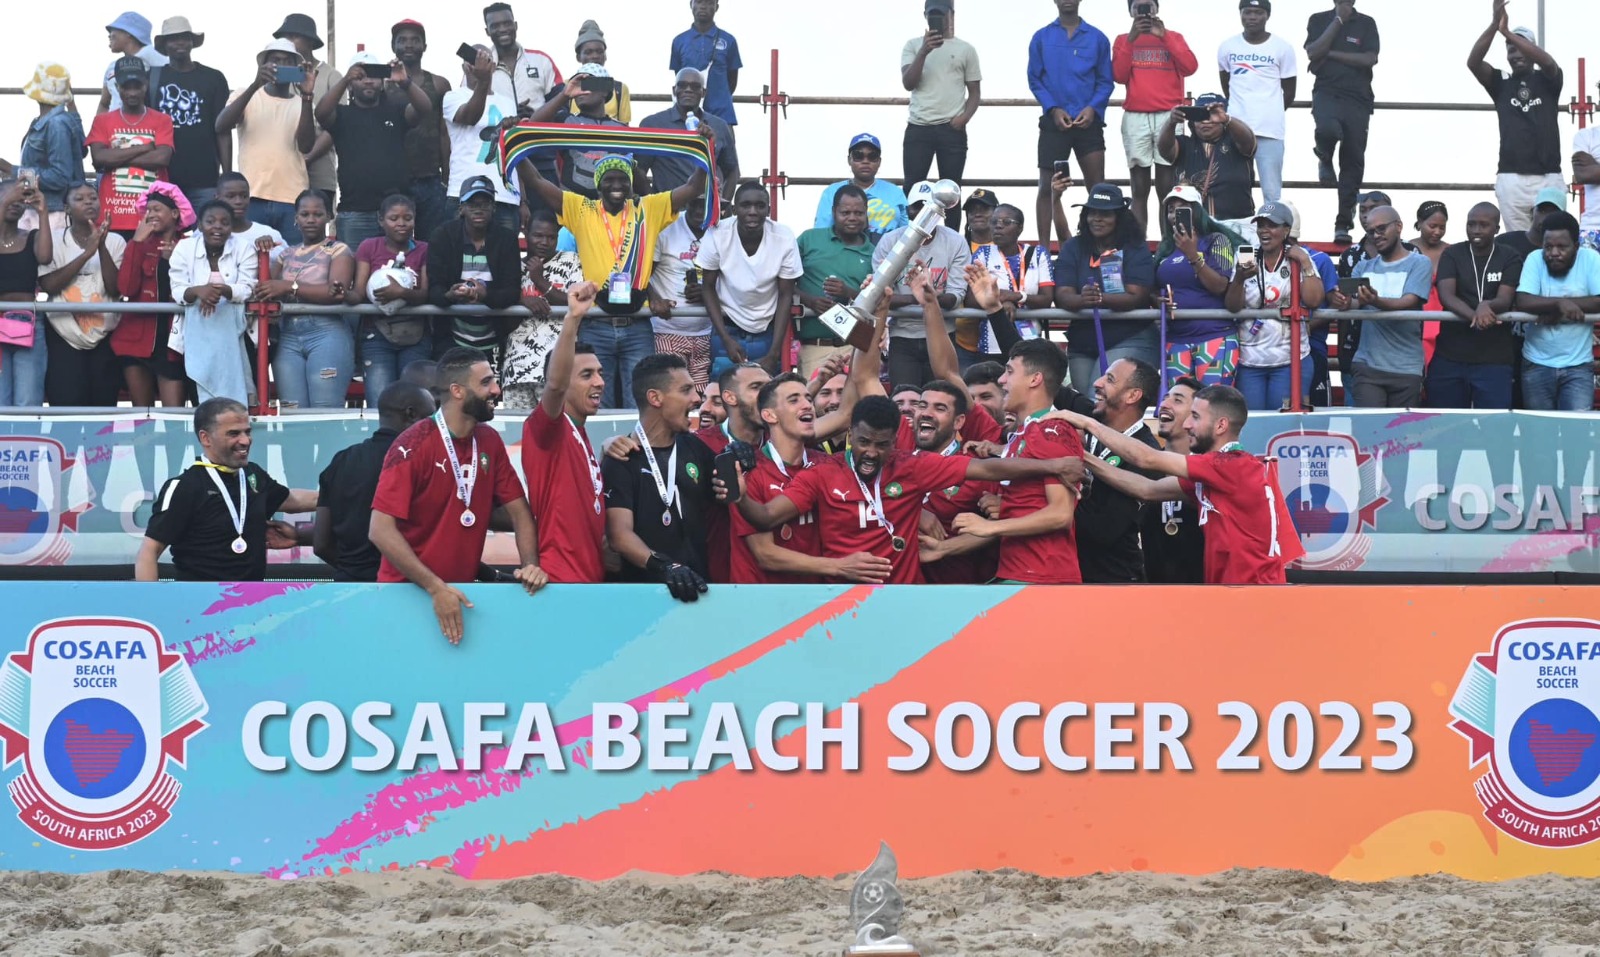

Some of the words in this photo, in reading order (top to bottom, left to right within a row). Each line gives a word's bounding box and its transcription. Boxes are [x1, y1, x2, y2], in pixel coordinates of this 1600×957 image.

[1229, 53, 1275, 64] Reebok
[106, 197, 136, 207] Working
[0, 450, 53, 462] SAFA
[1277, 444, 1348, 459] COSAFA
[0, 465, 29, 473] BEACH
[1299, 461, 1327, 470] BEACH
[1297, 470, 1329, 478] SOCCER
[1414, 483, 1600, 531] COSAF
[858, 500, 886, 528] 14
[43, 640, 147, 660] COSAFA
[75, 665, 115, 676] BEACH
[1538, 666, 1577, 676] BEACH
[73, 677, 118, 688] SOCCER
[1536, 678, 1579, 689] SOCCER
[241, 700, 566, 771] COSAFA
[593, 701, 860, 771] BEACH
[886, 700, 1194, 771] SOCCER
[1216, 700, 1415, 771] 2023
[32, 809, 76, 839] SOUTH
[77, 827, 126, 841] AFRICA
[126, 808, 158, 833] 2023
[1497, 807, 1539, 837] SOUTH
[1541, 824, 1589, 839] AFRICA
